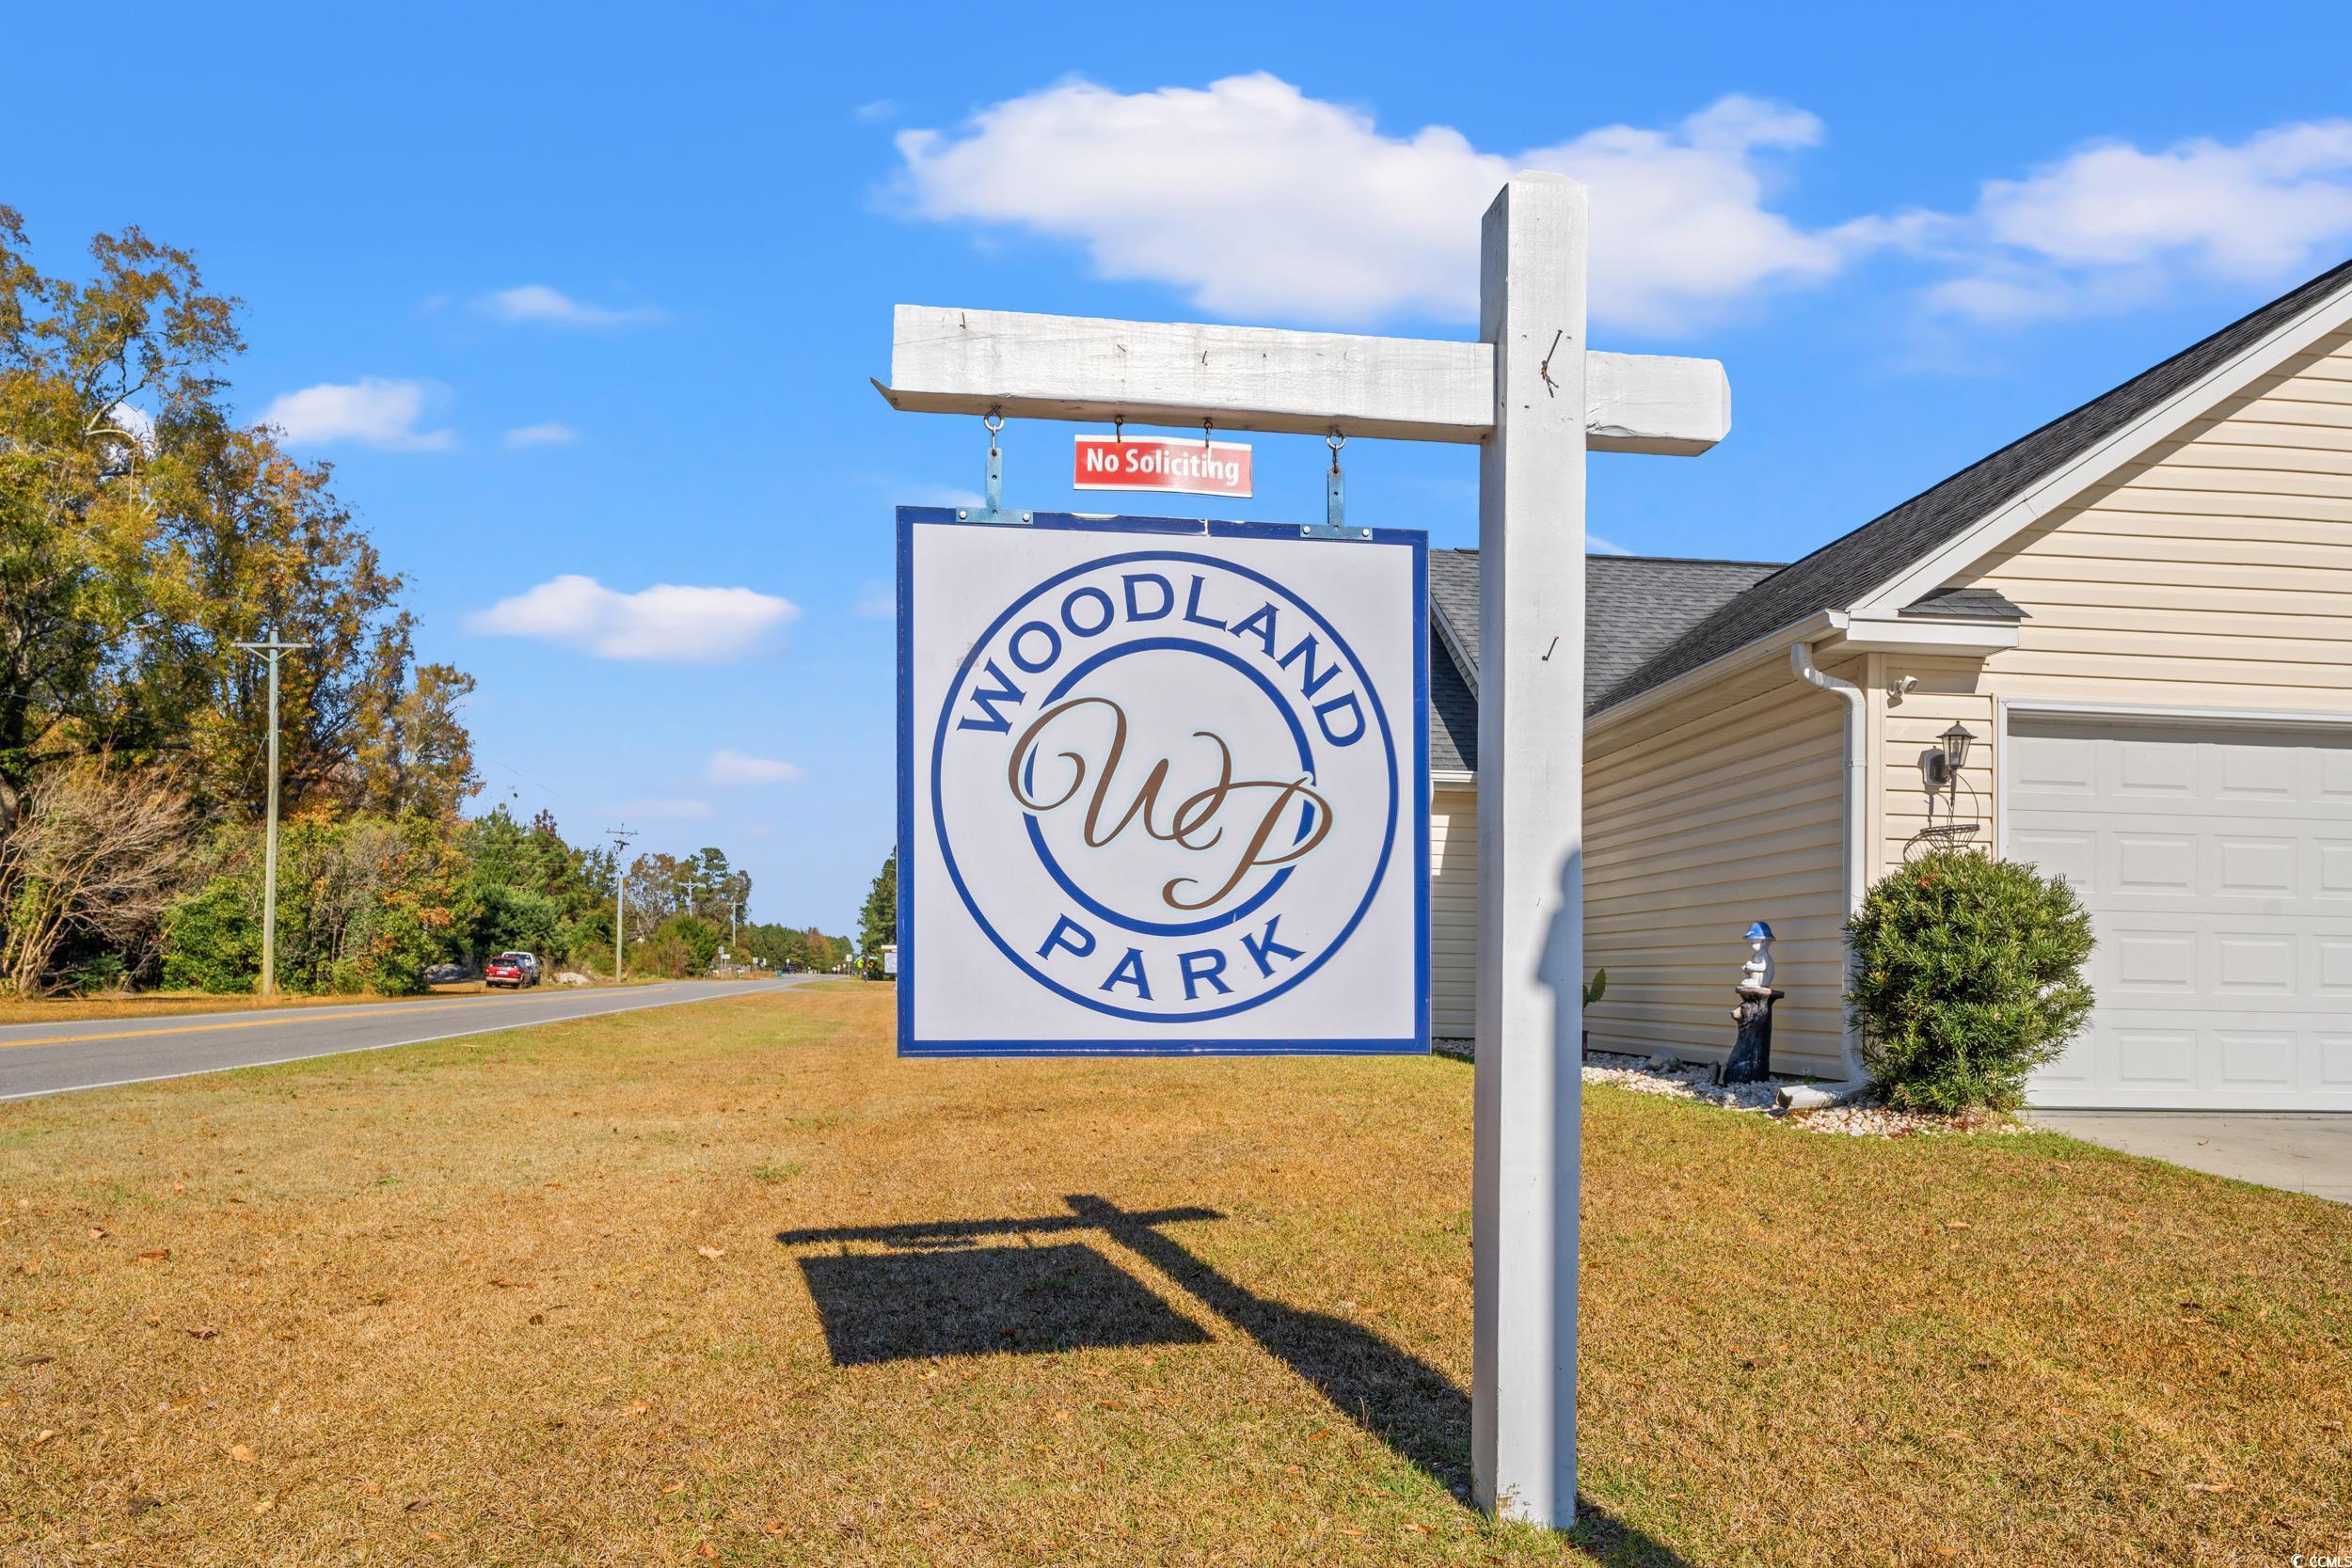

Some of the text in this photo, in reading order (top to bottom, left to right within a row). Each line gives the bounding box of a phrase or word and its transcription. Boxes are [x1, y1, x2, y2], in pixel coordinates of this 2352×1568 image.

[1087, 448, 1240, 487] No Soliciting
[958, 573, 1367, 749] WOODLAND
[1035, 913, 1306, 1002] PARK
